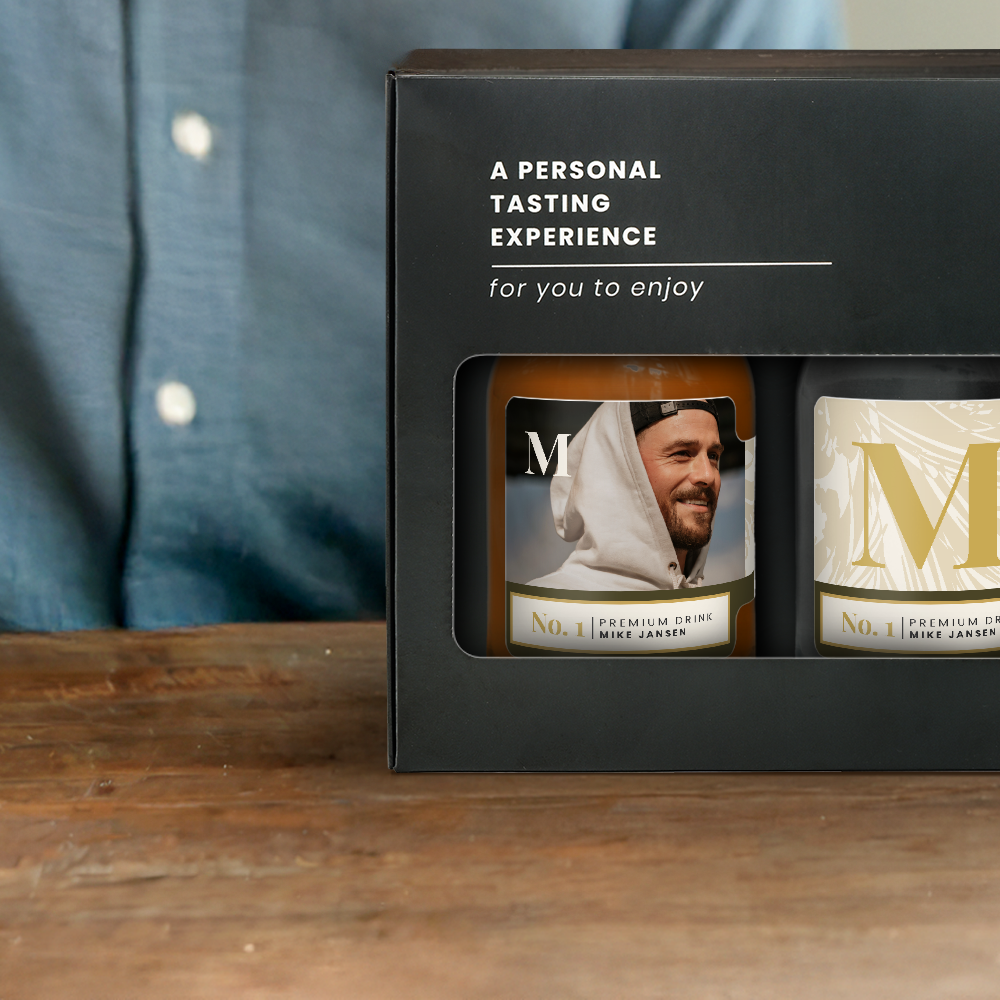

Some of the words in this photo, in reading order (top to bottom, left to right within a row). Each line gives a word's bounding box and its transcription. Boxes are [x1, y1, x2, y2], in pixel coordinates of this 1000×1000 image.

[490, 161, 508, 180] A
[518, 160, 661, 180] PERSONAL
[490, 193, 611, 214] TASTING
[490, 226, 657, 247] EXPERIENCE
[489, 278, 527, 298] for
[536, 280, 584, 303] you
[594, 278, 620, 297] to
[630, 276, 704, 302] enjoy
[524, 430, 572, 478] M
[531, 611, 568, 637] No.
[575, 621, 585, 637] 1
[599, 617, 668, 627] PREMIUM
[675, 612, 713, 625] DRINK
[841, 611, 878, 637] No.
[885, 621, 895, 637] 1
[909, 617, 978, 627] PREMIUM
[599, 630, 632, 639] MIKE
[638, 628, 686, 639] JANSEN
[909, 630, 942, 639] MIKE
[948, 628, 996, 639] JANSEN
